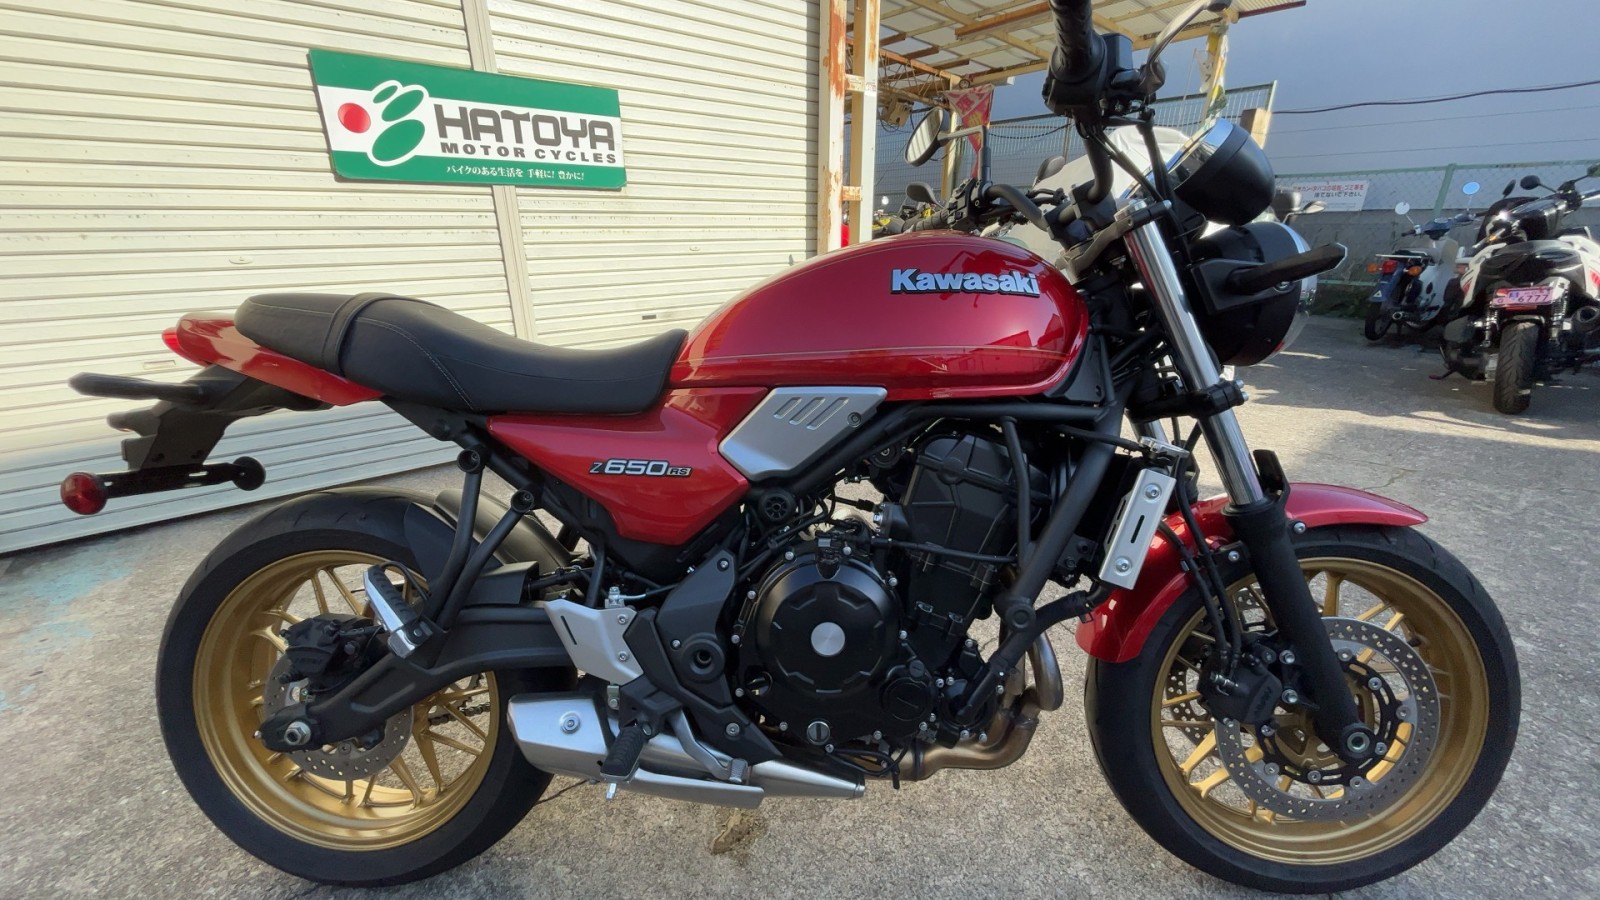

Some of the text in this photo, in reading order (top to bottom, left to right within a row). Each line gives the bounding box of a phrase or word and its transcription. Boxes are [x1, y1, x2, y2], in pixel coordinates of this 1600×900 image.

[433, 103, 615, 151] HATOYA
[441, 142, 617, 164] MOTOR CYCLES
[446, 165, 524, 177] バイクのある生活を
[891, 268, 1040, 297] Kawasaki
